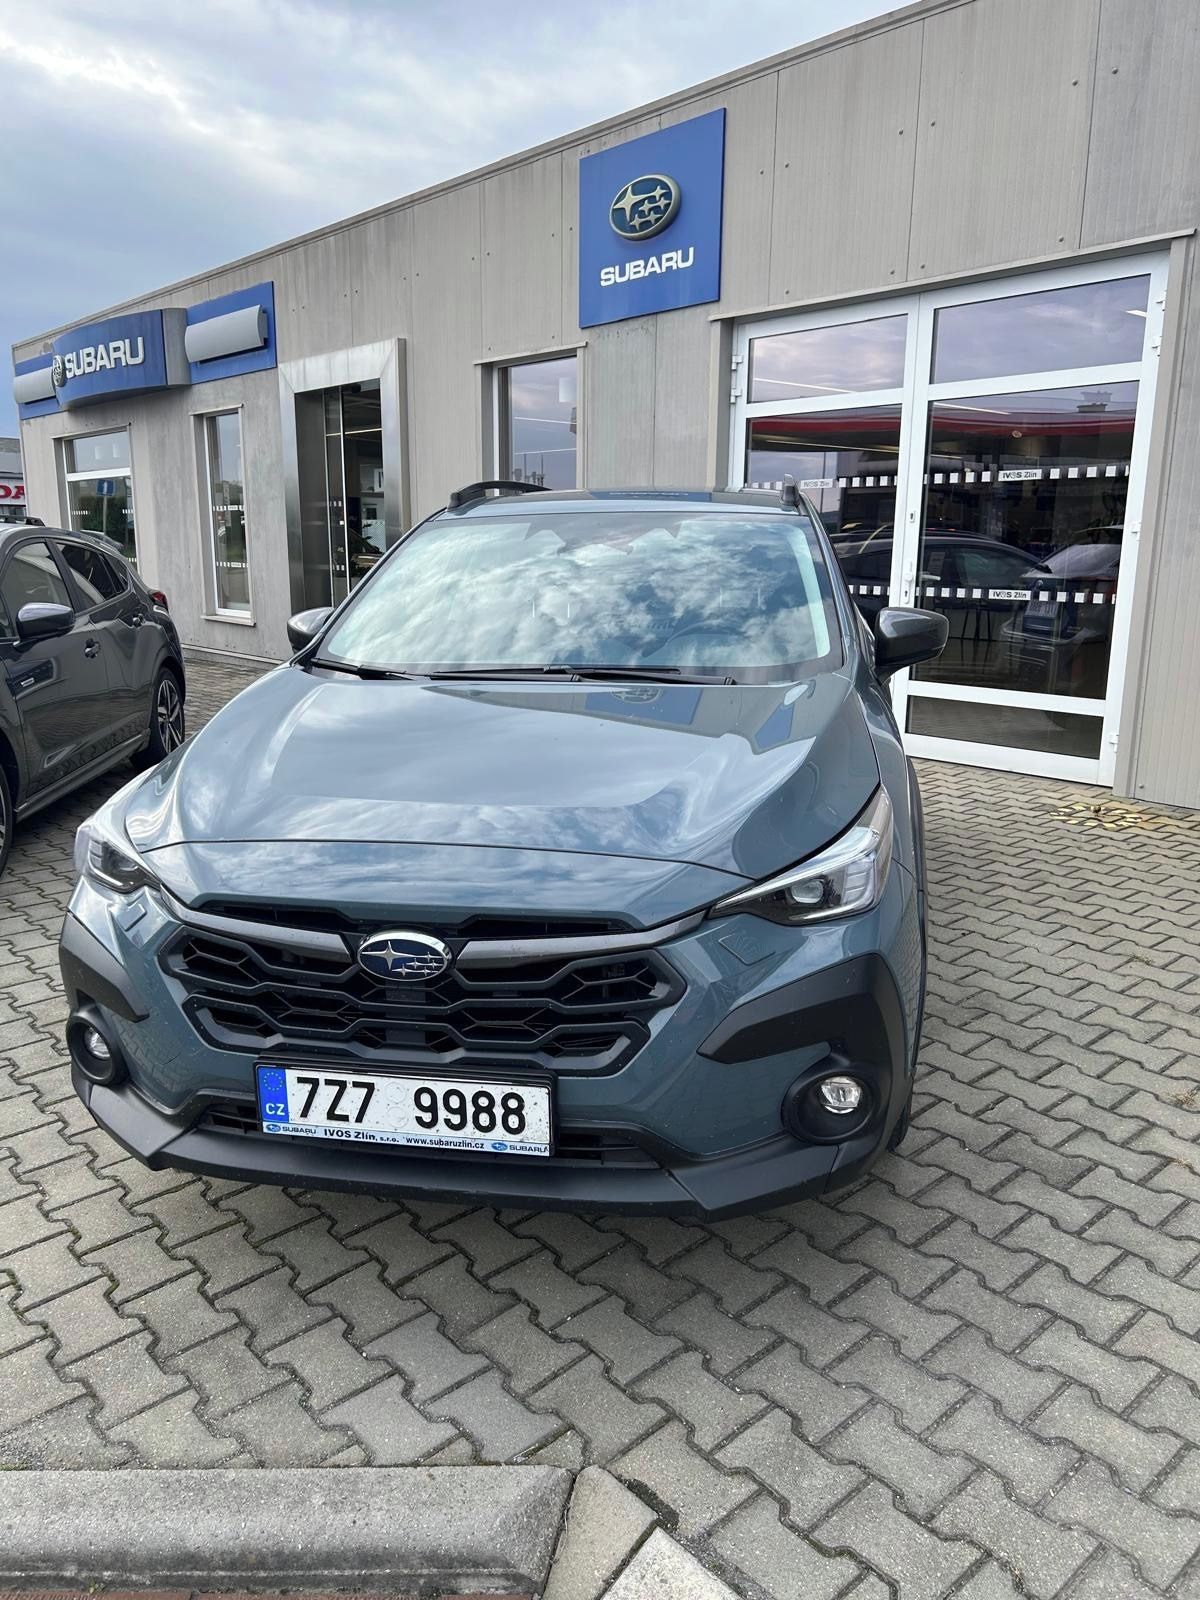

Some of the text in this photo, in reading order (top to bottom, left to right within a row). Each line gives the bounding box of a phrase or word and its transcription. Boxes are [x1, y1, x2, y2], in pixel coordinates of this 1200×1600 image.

[600, 247, 694, 287] SUBARU
[64, 336, 144, 379] SUBARU
[265, 1103, 286, 1116] CZ
[297, 1076, 526, 1135] 7Z7 9988
[282, 1126, 317, 1135] SUBARU
[324, 1128, 352, 1138] IVOS
[406, 1136, 485, 1150] www.subaruzlin.cz
